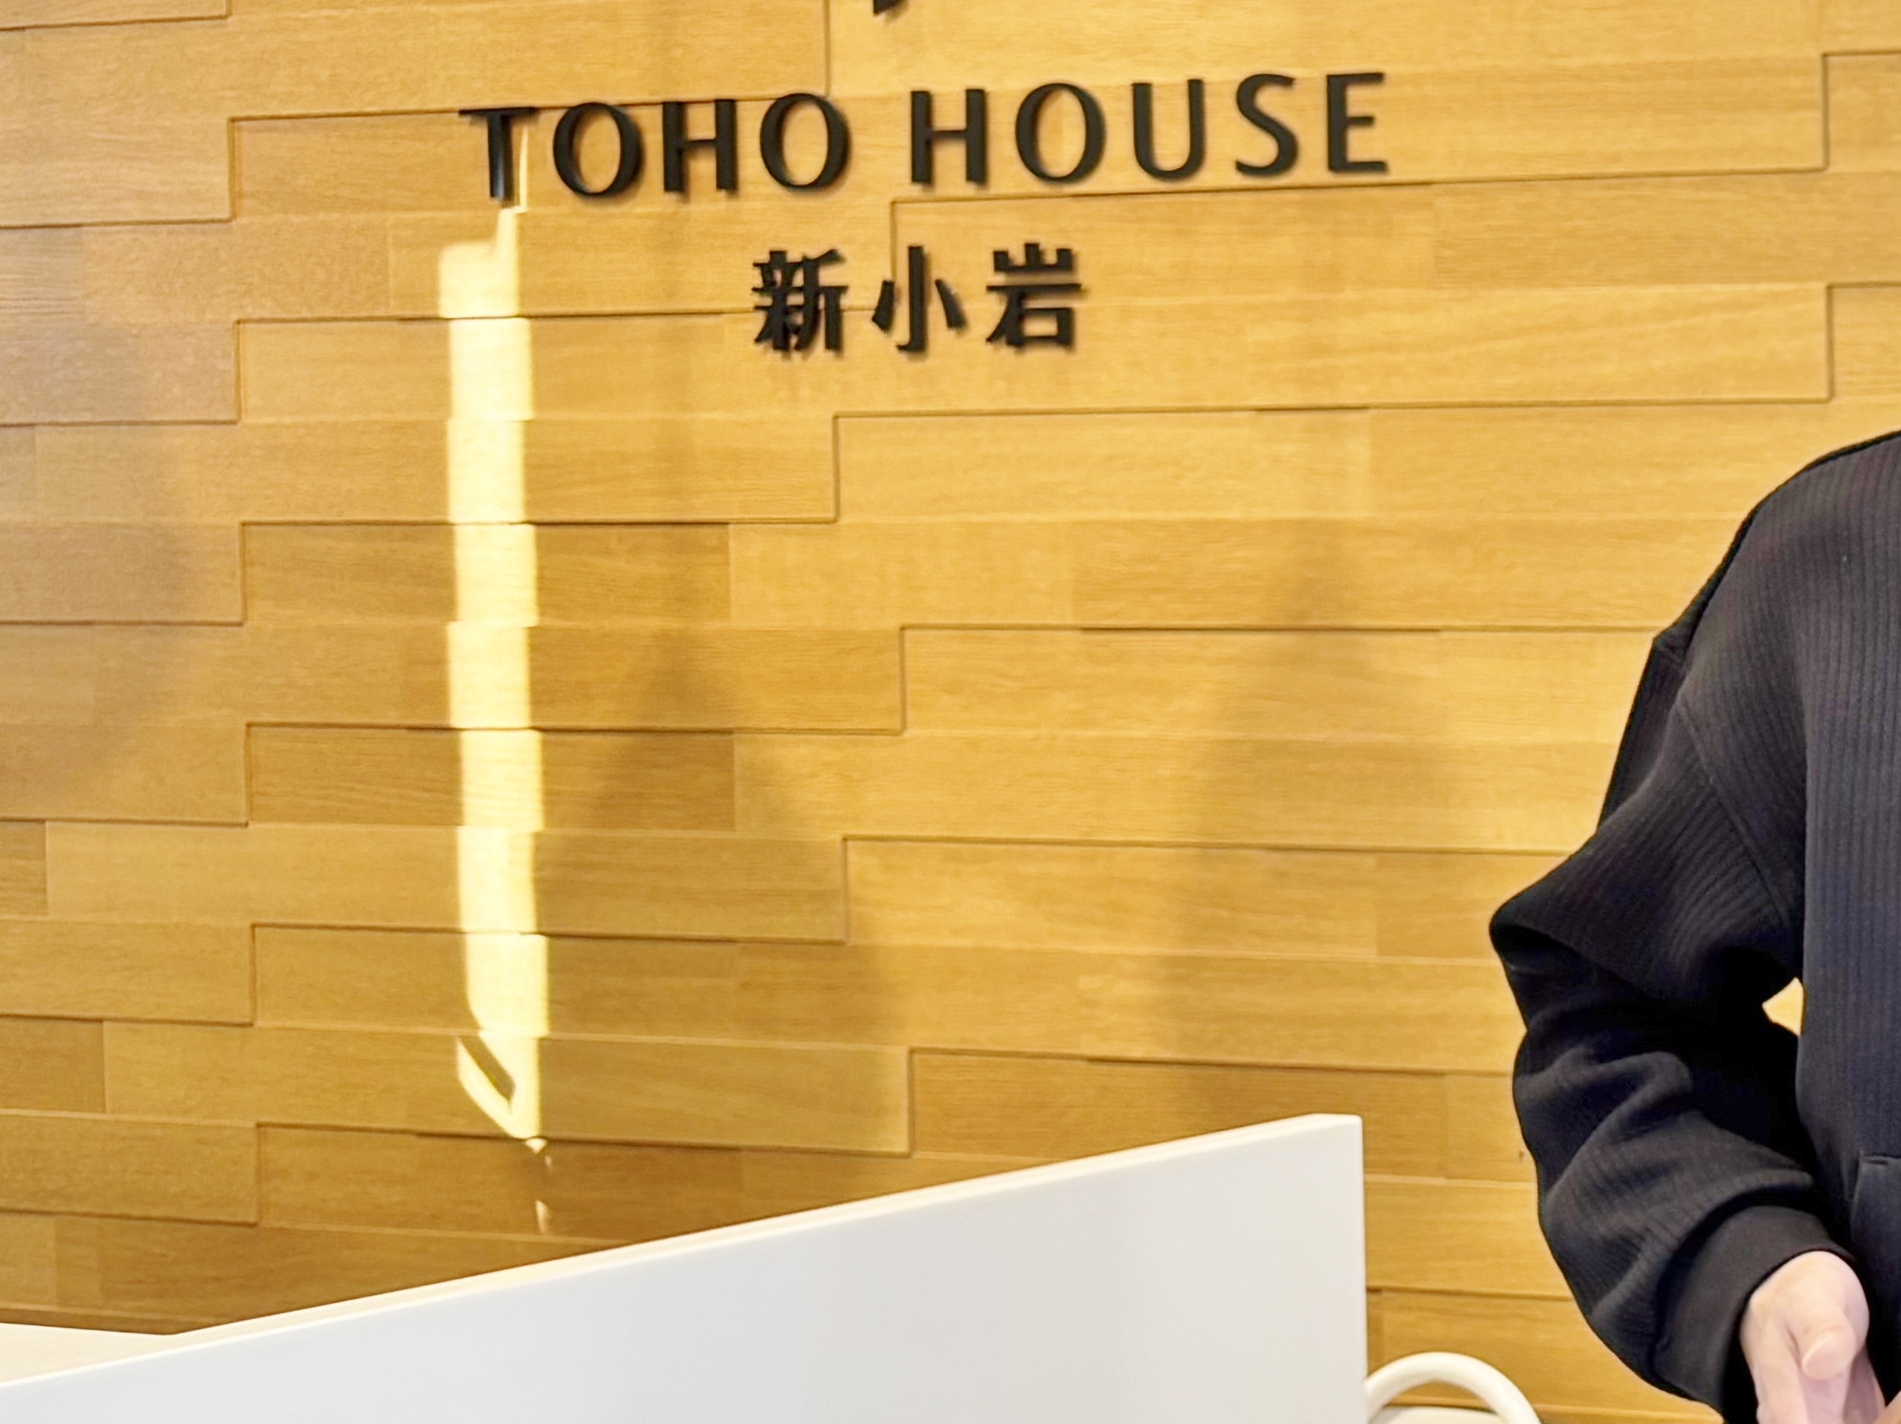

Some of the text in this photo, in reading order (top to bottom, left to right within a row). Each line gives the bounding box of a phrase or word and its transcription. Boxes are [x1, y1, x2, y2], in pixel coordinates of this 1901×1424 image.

[458, 72, 1389, 209] TOHO HOUSE
[752, 242, 1082, 356] 新小岩
